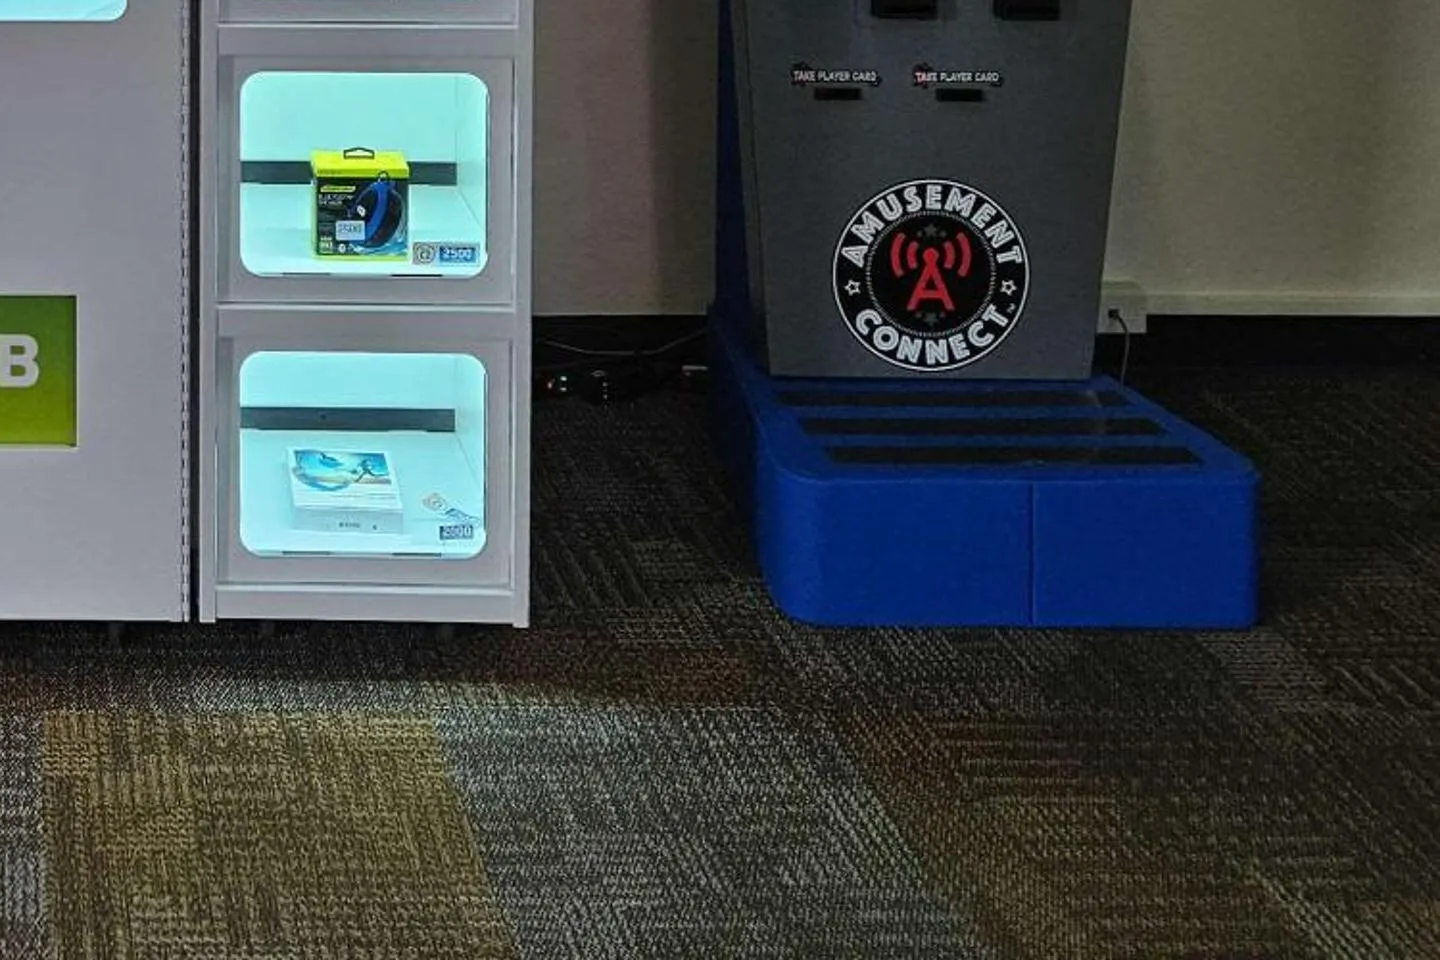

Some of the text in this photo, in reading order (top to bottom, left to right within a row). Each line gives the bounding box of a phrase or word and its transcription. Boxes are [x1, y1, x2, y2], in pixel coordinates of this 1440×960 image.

[793, 70, 877, 82] TAKE PLAYER CARD
[915, 71, 1000, 83] TAKE PLAYER CARD
[841, 184, 1023, 268] AMUSEMENT
[442, 248, 472, 260] 2500
[855, 304, 1009, 365] CONNECT
